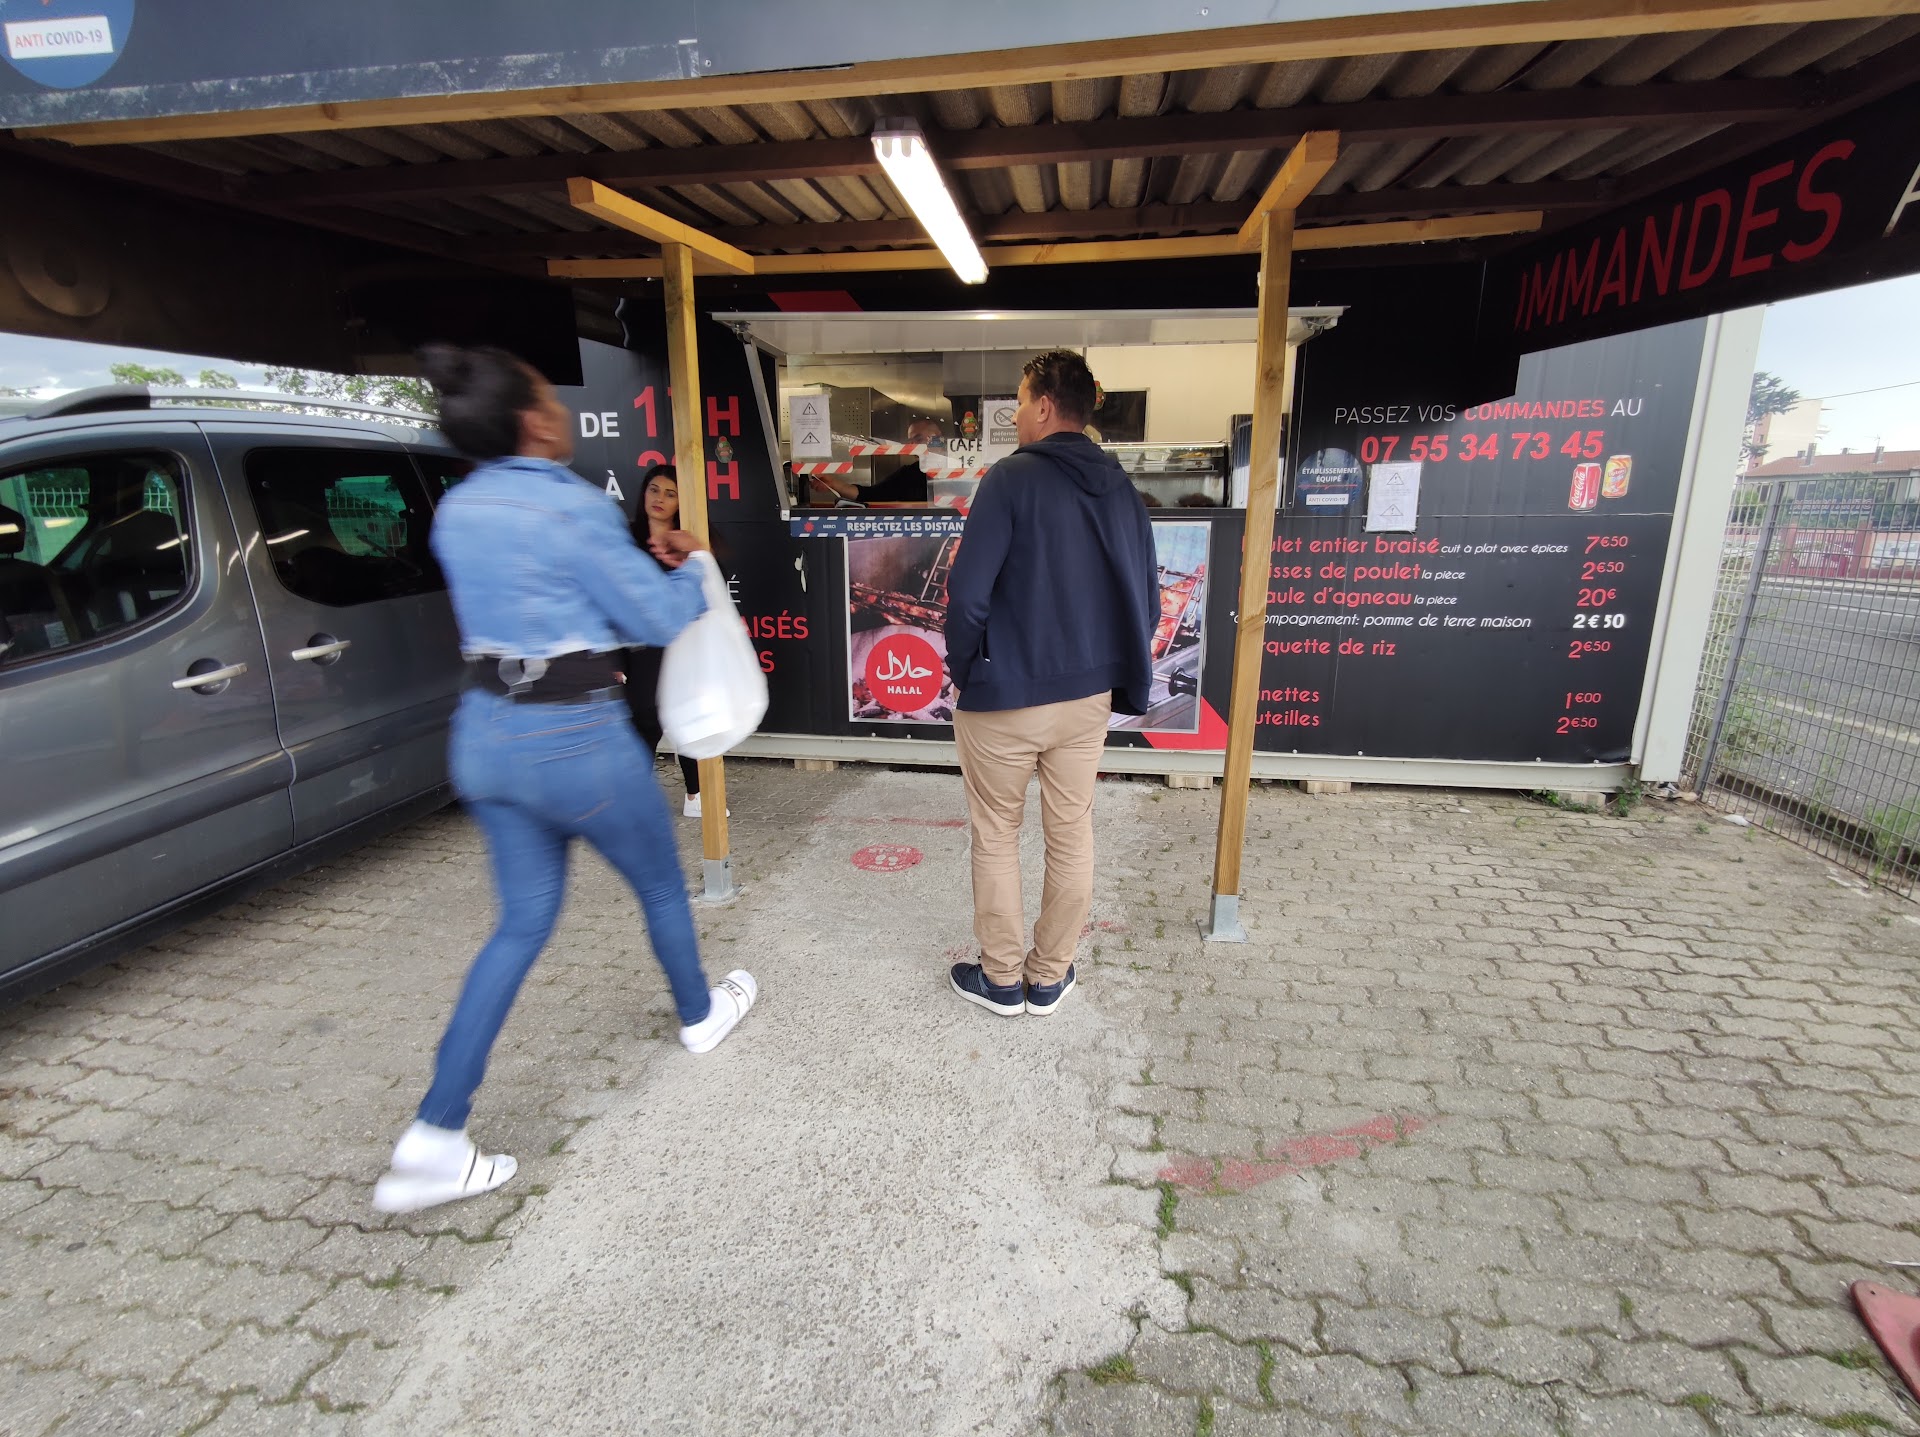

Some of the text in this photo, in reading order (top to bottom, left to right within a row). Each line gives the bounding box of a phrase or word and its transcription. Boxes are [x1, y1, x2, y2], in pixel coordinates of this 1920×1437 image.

[15, 29, 103, 48] ANTI COVID-19
[579, 386, 740, 438] DE 1 H
[1334, 398, 1643, 425] PASSEZ VOS COMMANDES AU
[1360, 430, 1605, 463] 07 55 34 73 45
[605, 461, 740, 500] À H
[1302, 467, 1358, 475] ÉTABLISSEMENT
[1316, 475, 1342, 483] ÉQUIPÉ
[847, 522, 902, 532] RESPECTEZ
[904, 522, 922, 532] LES
[925, 521, 965, 531] DISTAN
[1309, 537, 1369, 553] entier
[1375, 536, 1440, 555] braisé
[1441, 544, 1461, 554] cuit
[1463, 543, 1472, 553] à
[1474, 543, 1498, 555] plat
[1500, 545, 1529, 553] avec
[1531, 544, 1569, 555] épices
[1584, 535, 1629, 554] 7€50
[1240, 561, 1466, 582] isses de poulet la pièce
[1581, 561, 1625, 580] 2€50
[1313, 587, 1412, 608] d'agneau
[1413, 595, 1424, 605] la
[1426, 595, 1457, 606] pièce
[1576, 588, 1617, 607] 20€
[740, 610, 809, 639] AISÉS
[1363, 614, 1414, 628] pomme
[1418, 613, 1438, 627] de
[1444, 614, 1477, 627] terre
[1480, 615, 1532, 628] maison
[1338, 638, 1364, 655] de
[1372, 640, 1396, 655] riz
[1568, 640, 1611, 658] 2€50
[876, 650, 933, 680] حلال
[887, 686, 922, 695] HALAL
[1258, 688, 1320, 702] nettes
[1565, 692, 1602, 709] 1€00
[1255, 710, 1320, 727] uteilles
[1556, 717, 1598, 734] 2€50
